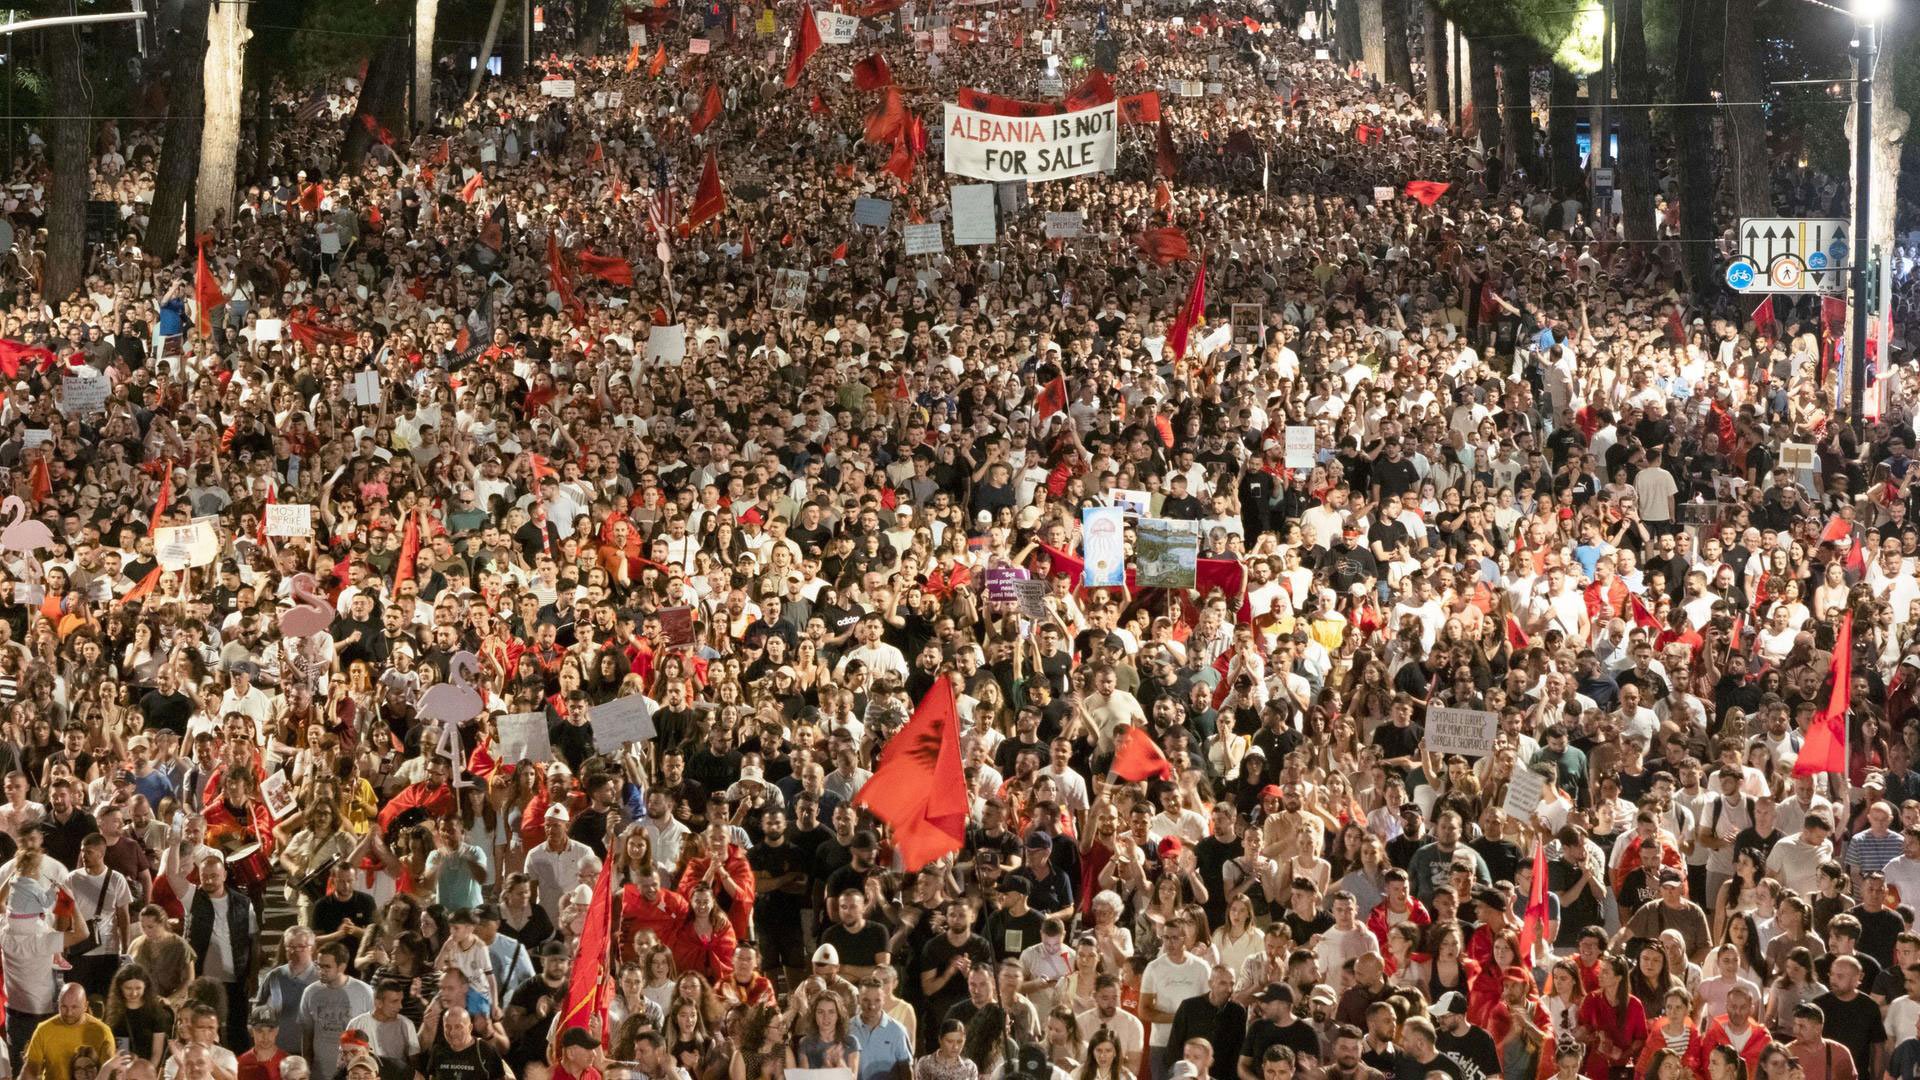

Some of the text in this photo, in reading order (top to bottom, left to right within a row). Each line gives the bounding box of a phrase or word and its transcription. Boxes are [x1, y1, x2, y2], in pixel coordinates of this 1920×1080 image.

[950, 109, 1115, 143] ALBANIA IS NOT
[986, 141, 1095, 175] FOR SALE
[837, 615, 860, 626] adidas
